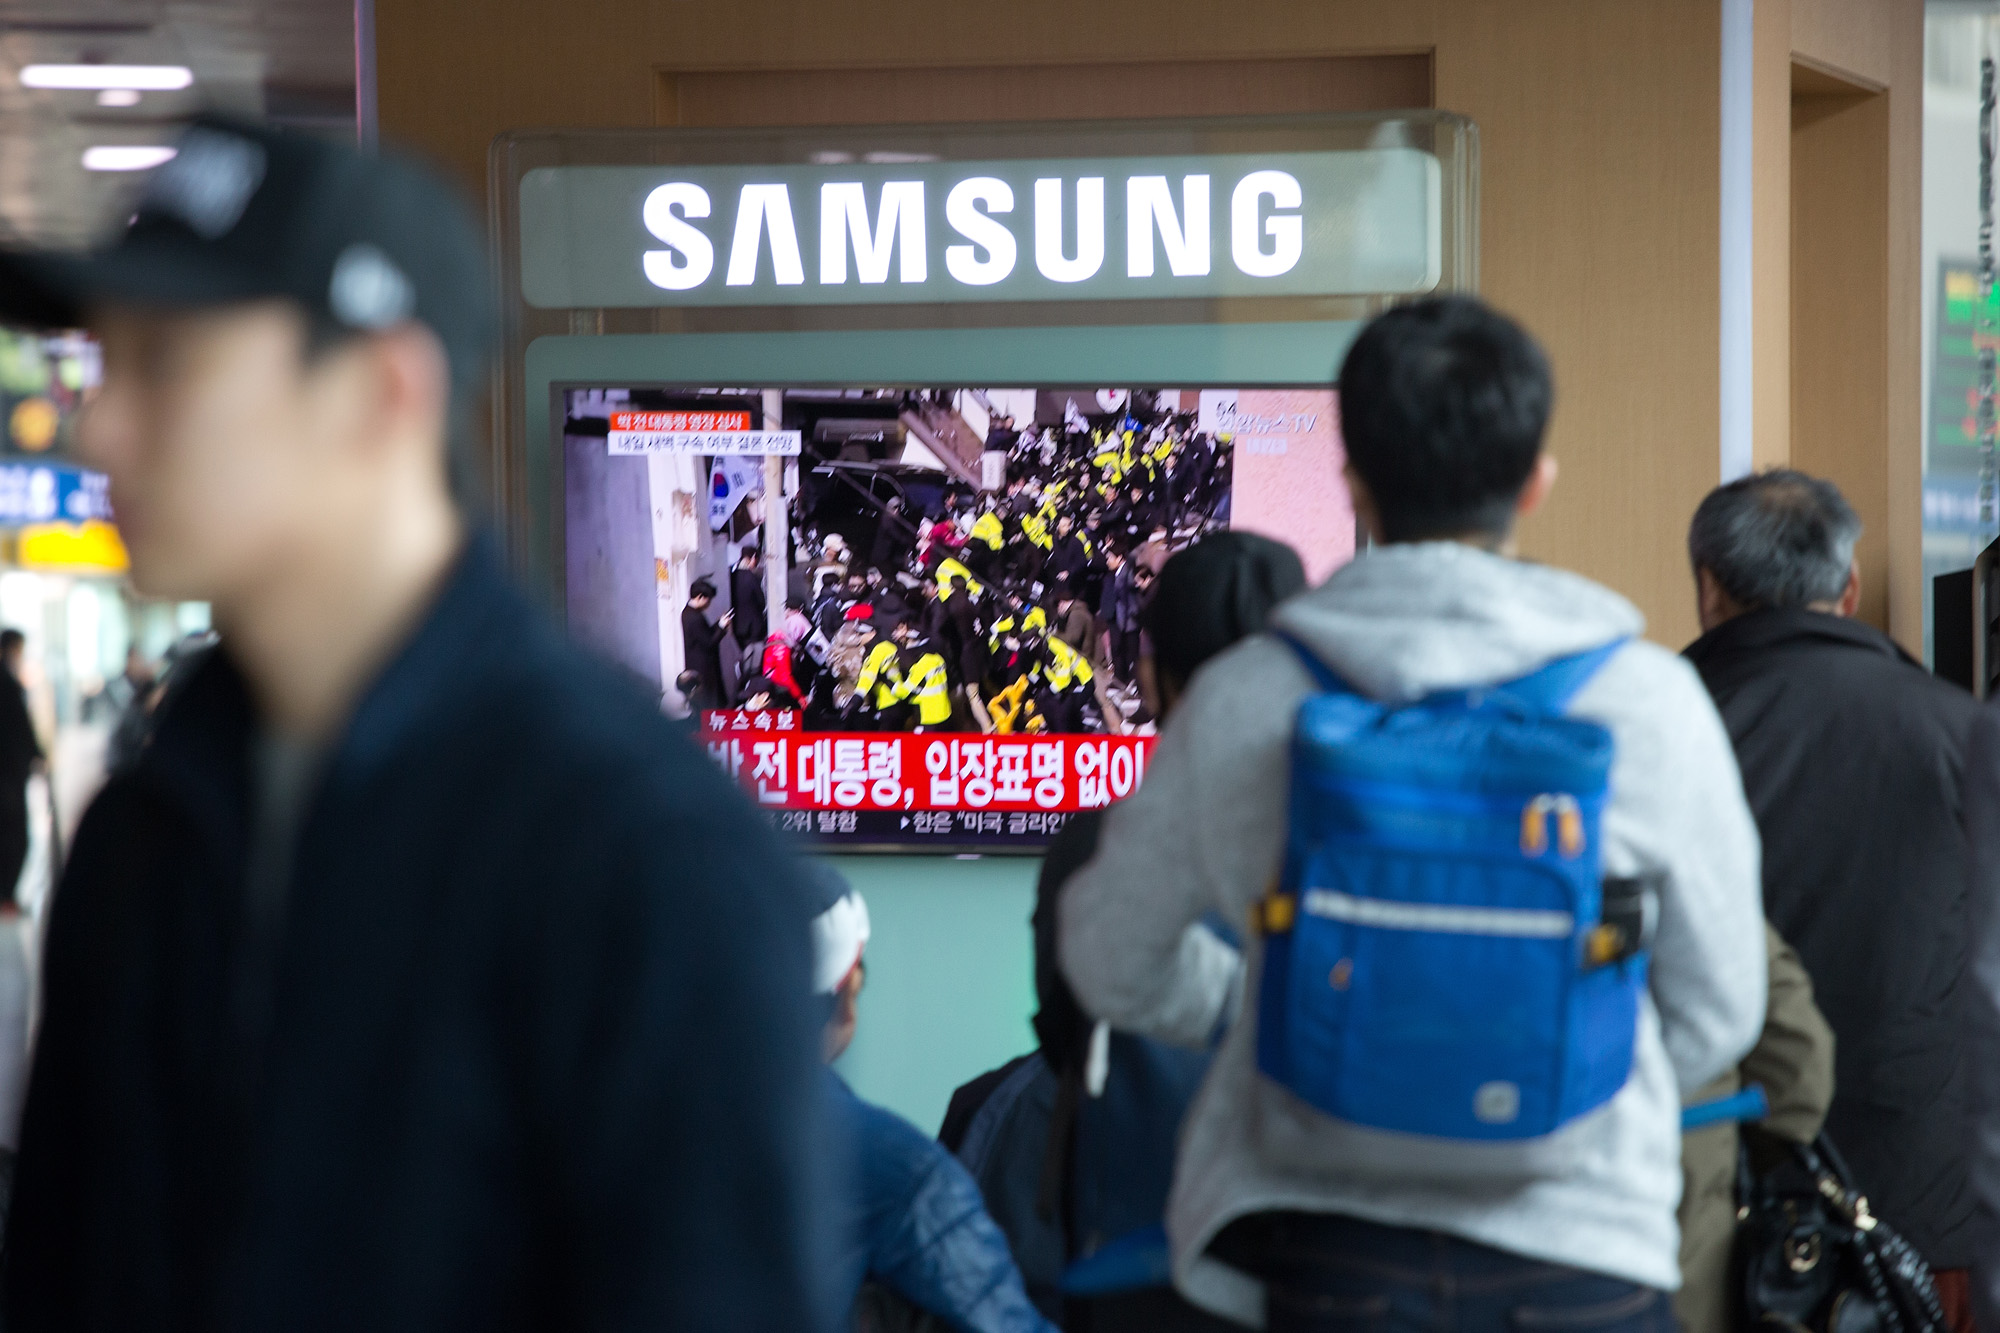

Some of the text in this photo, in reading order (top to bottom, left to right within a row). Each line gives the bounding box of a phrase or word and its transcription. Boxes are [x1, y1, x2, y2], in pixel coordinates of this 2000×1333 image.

[643, 170, 1303, 291] SAMSUNG
[751, 738, 788, 804] 전
[797, 738, 914, 810] 대통령,
[925, 739, 1065, 808] 입장표명
[1074, 740, 1144, 808] 없이
[782, 810, 812, 833] 2위
[817, 810, 859, 833] 탈환
[912, 811, 952, 834] 한은
[1007, 811, 1075, 835] 금리인
